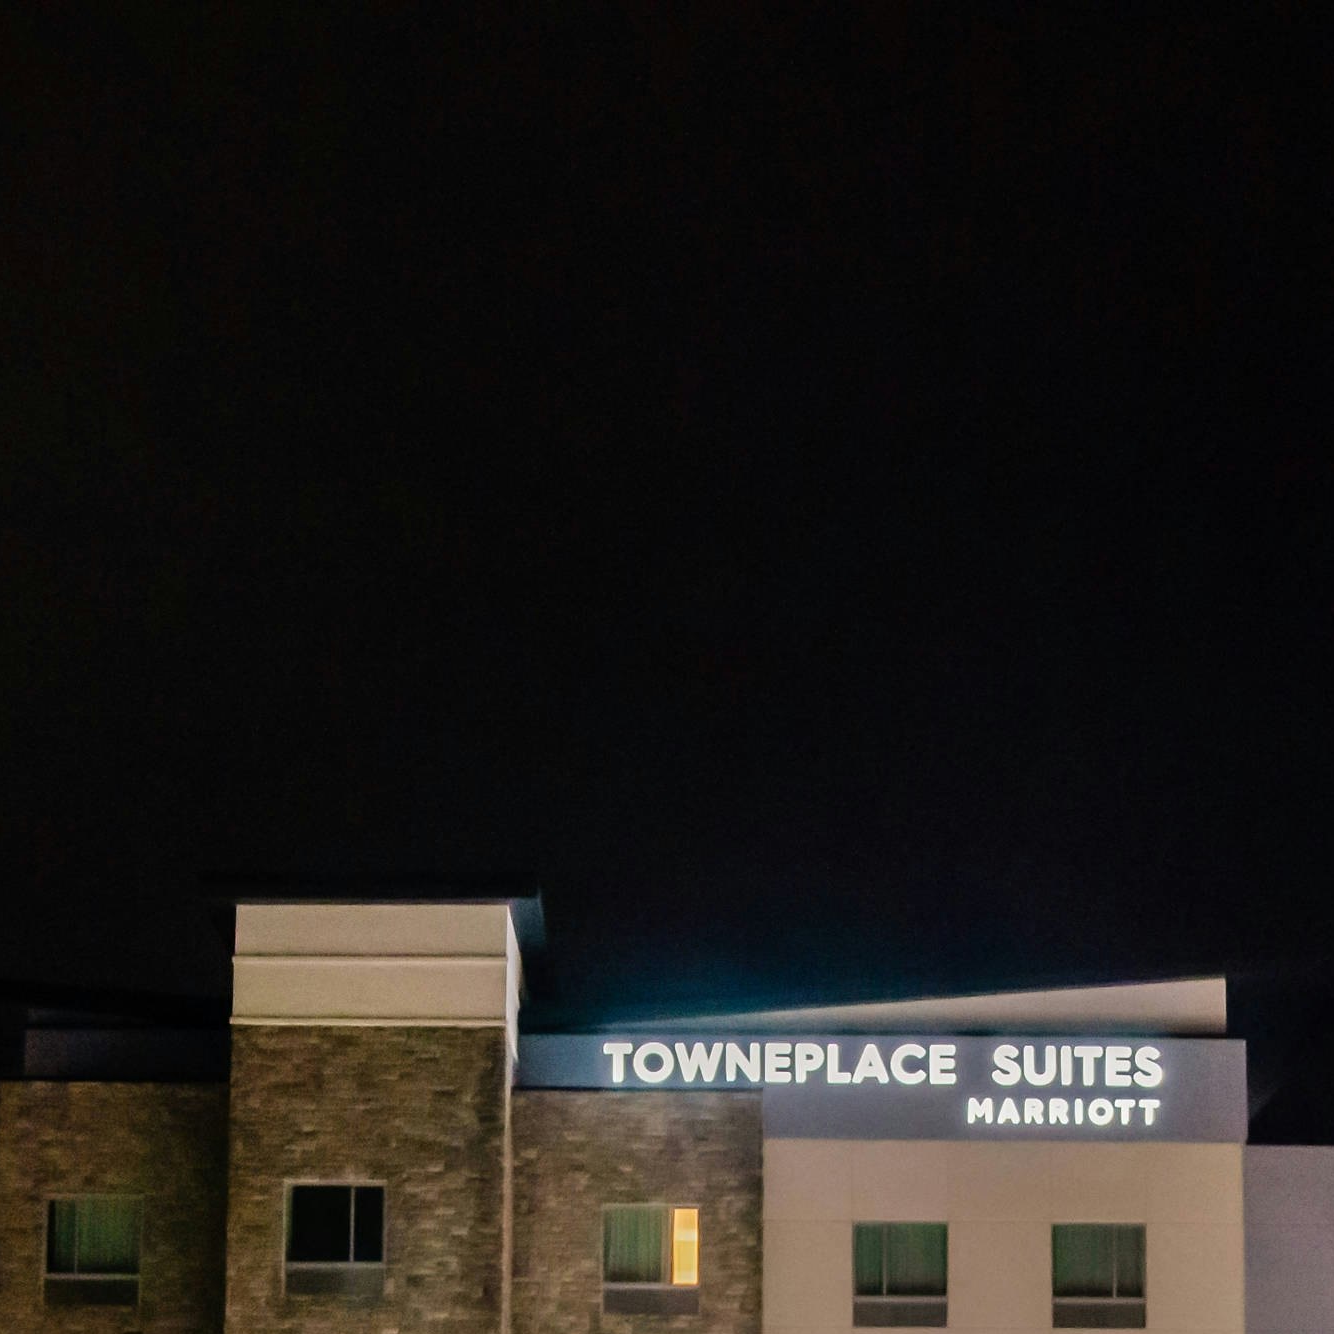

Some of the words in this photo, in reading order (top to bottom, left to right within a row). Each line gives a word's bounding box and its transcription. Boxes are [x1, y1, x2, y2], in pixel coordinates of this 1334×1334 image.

[602, 1041, 957, 1085] TOWNEPLACE
[991, 1043, 1164, 1087] SUITES
[966, 1096, 1161, 1126] MARRIOTT
